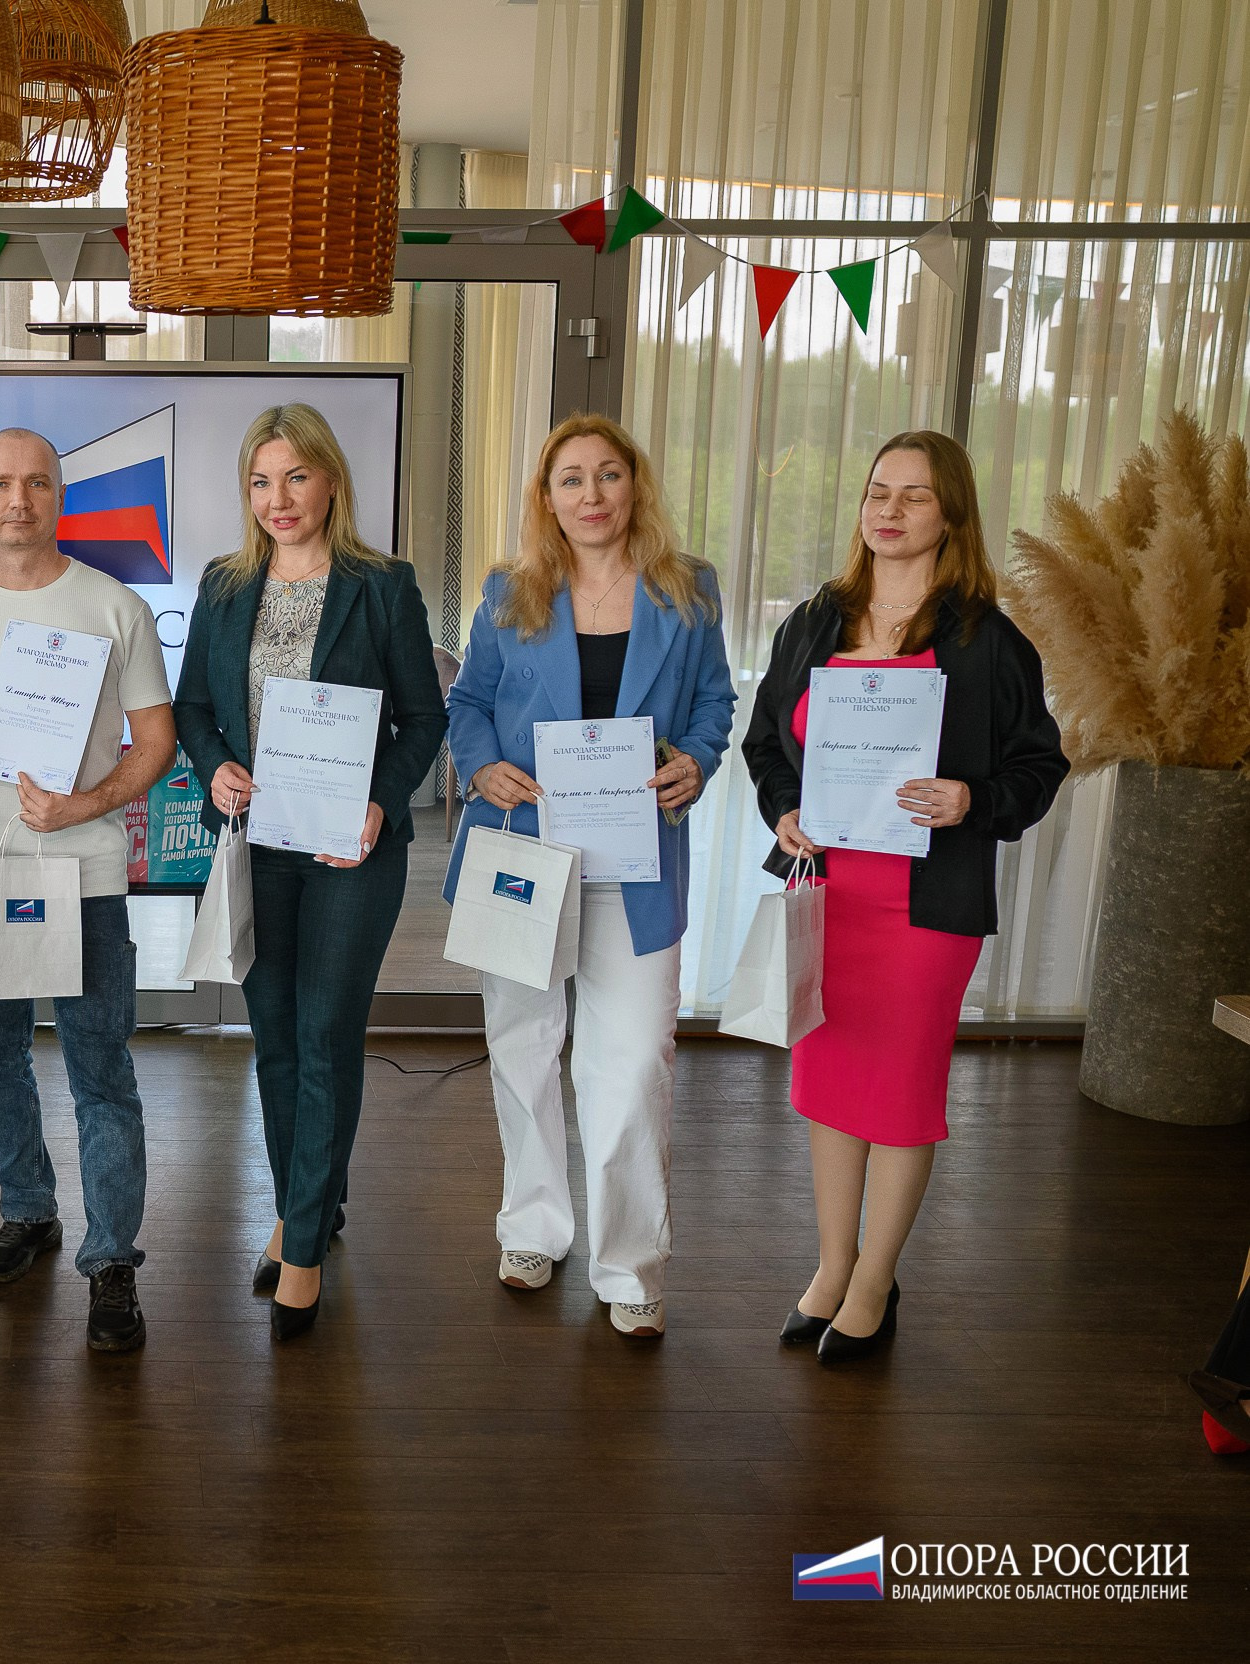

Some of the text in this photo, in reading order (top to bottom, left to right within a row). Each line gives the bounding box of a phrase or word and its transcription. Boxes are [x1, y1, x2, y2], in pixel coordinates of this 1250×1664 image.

[17, 647, 89, 668] БЛАГОДАРСТВЕННОЕ
[36, 658, 67, 669] ПИСЬМО
[5, 685, 47, 701] Дмитрий
[828, 696, 917, 705] БЛАГОДАРСТВЕННОЕ
[279, 705, 360, 722] БЛАГОДАРСТВЕННОЕ
[853, 704, 890, 712] ПИСЬМО
[302, 717, 335, 727] ПИСЬМО
[553, 745, 635, 755] БЛАГОДАРСТВЕННОЕ
[816, 741, 922, 753] Марина Дмитриева
[261, 747, 366, 768] Вероника Кожевникова
[164, 814, 196, 825] КОТОРАЯ
[161, 849, 186, 862] САМОЙ
